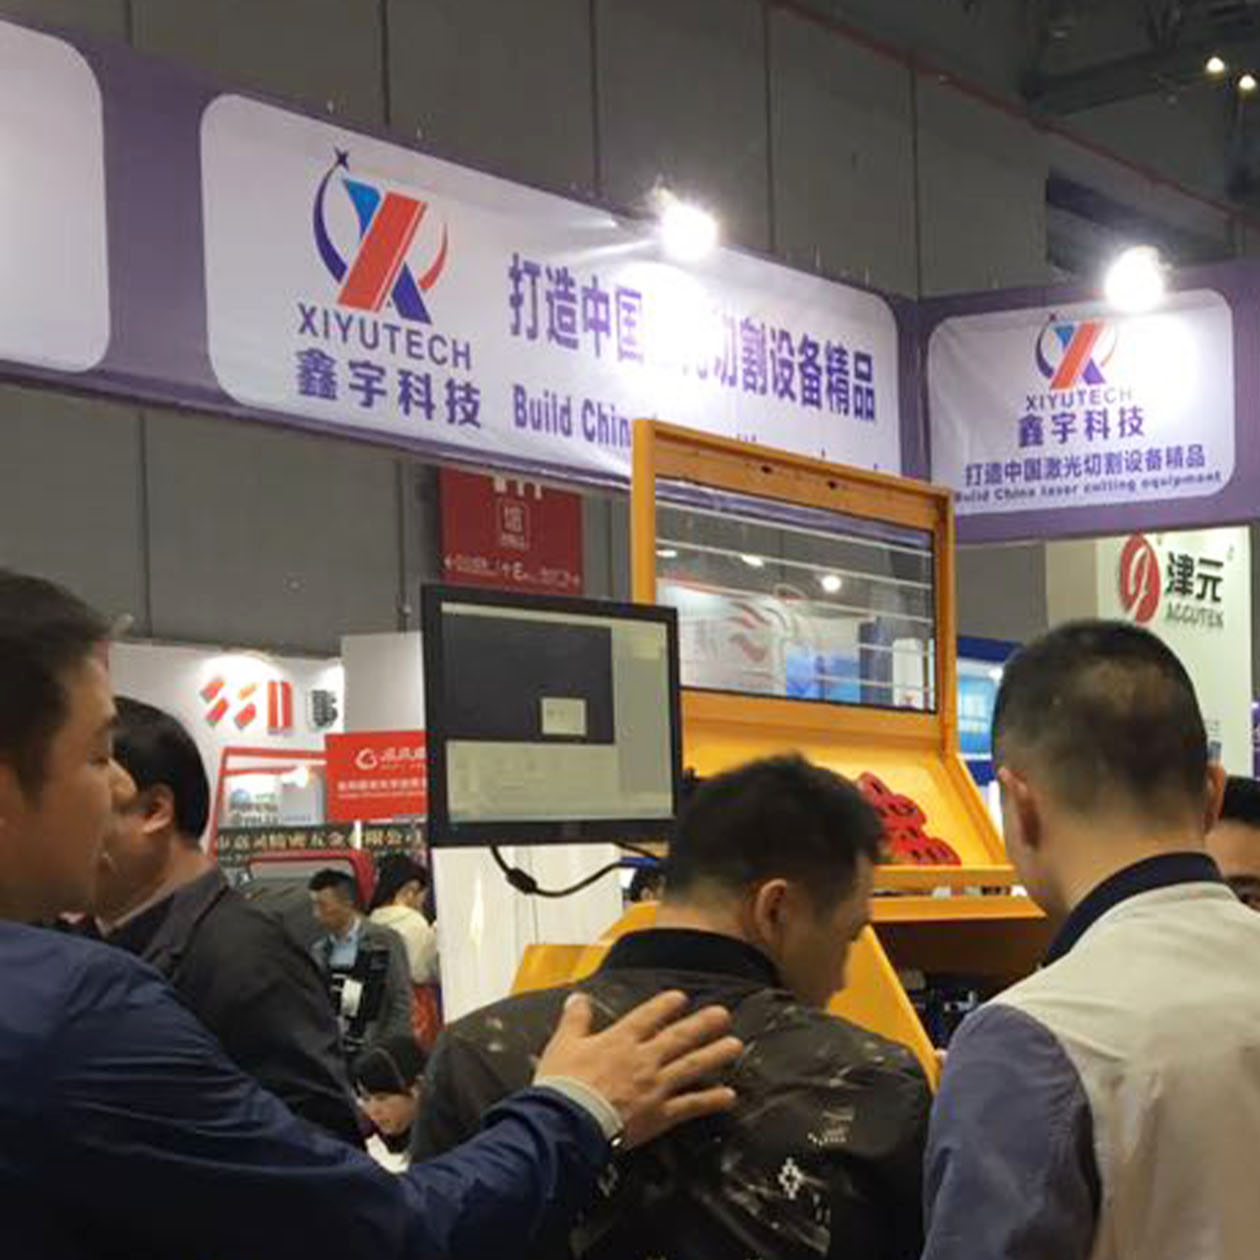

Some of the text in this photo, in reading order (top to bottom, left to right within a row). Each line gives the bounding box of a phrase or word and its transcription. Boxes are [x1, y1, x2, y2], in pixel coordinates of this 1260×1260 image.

[298, 303, 472, 371] XIYUTECH
[296, 347, 482, 429] 鑫宇科技
[1026, 388, 1133, 411] XIYUTECH
[513, 384, 632, 448] Build Chin
[1018, 405, 1146, 449] 鑫宇科技
[965, 444, 1206, 487] 打造中国激光切割设备精品
[1164, 550, 1224, 603] 津元
